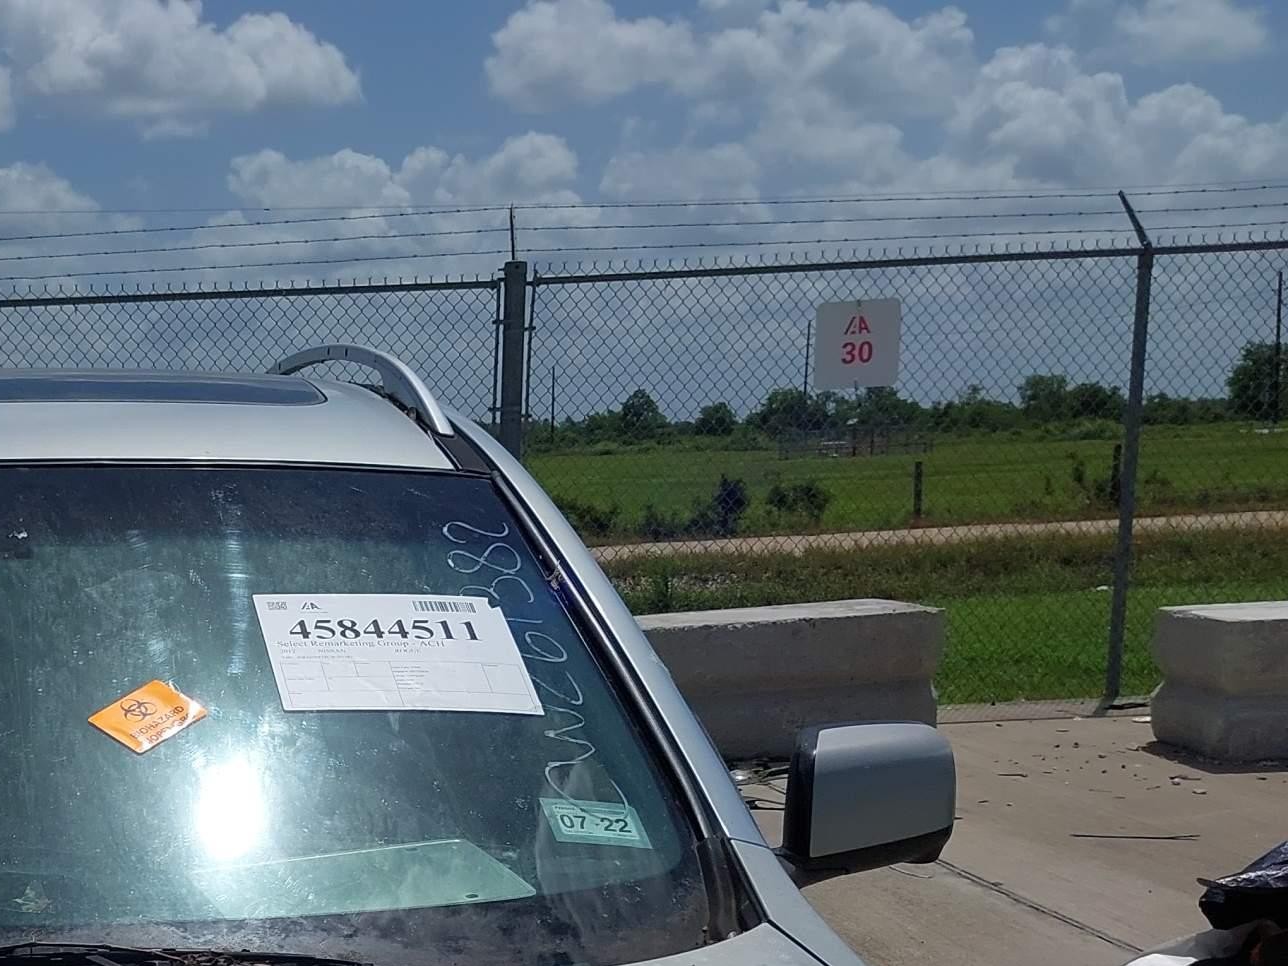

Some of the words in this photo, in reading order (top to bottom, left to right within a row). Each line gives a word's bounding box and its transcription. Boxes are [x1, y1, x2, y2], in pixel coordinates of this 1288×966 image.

[840, 340, 873, 365] 30
[289, 618, 483, 641] 45844511
[310, 640, 376, 649] Remarketing
[377, 640, 410, 649] Group
[129, 704, 184, 739] BIOHAZARD
